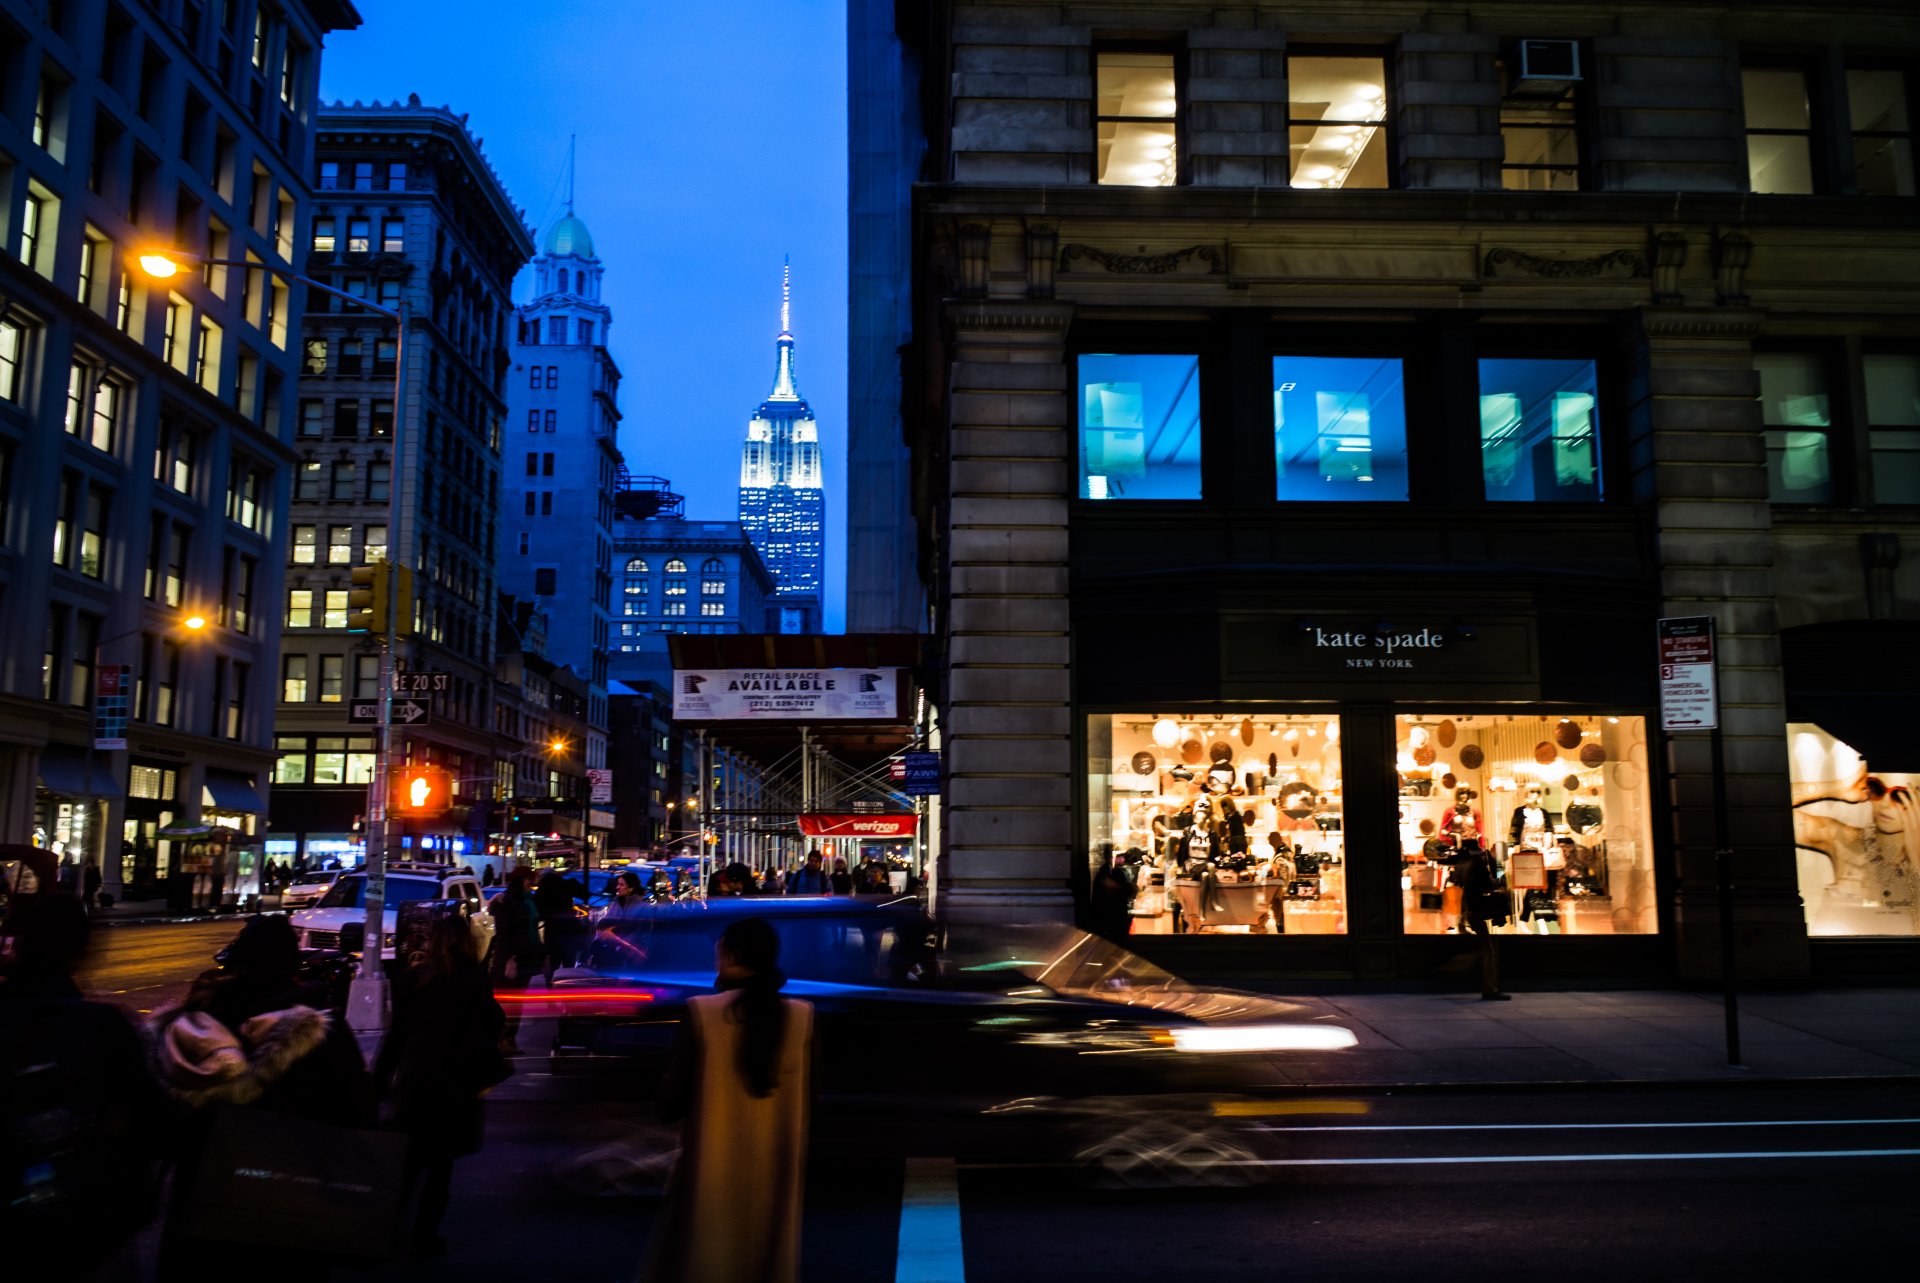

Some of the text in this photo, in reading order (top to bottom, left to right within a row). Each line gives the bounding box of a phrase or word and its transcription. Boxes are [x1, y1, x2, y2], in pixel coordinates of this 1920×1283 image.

[1316, 627, 1443, 654] kate spade
[1345, 659, 1414, 668] NEW YORK
[1663, 666, 1671, 679] 3
[400, 675, 448, 690] E 20 ST
[728, 680, 836, 691] AVAILABLE
[906, 769, 939, 778] FAWN
[852, 820, 900, 833] verizon
